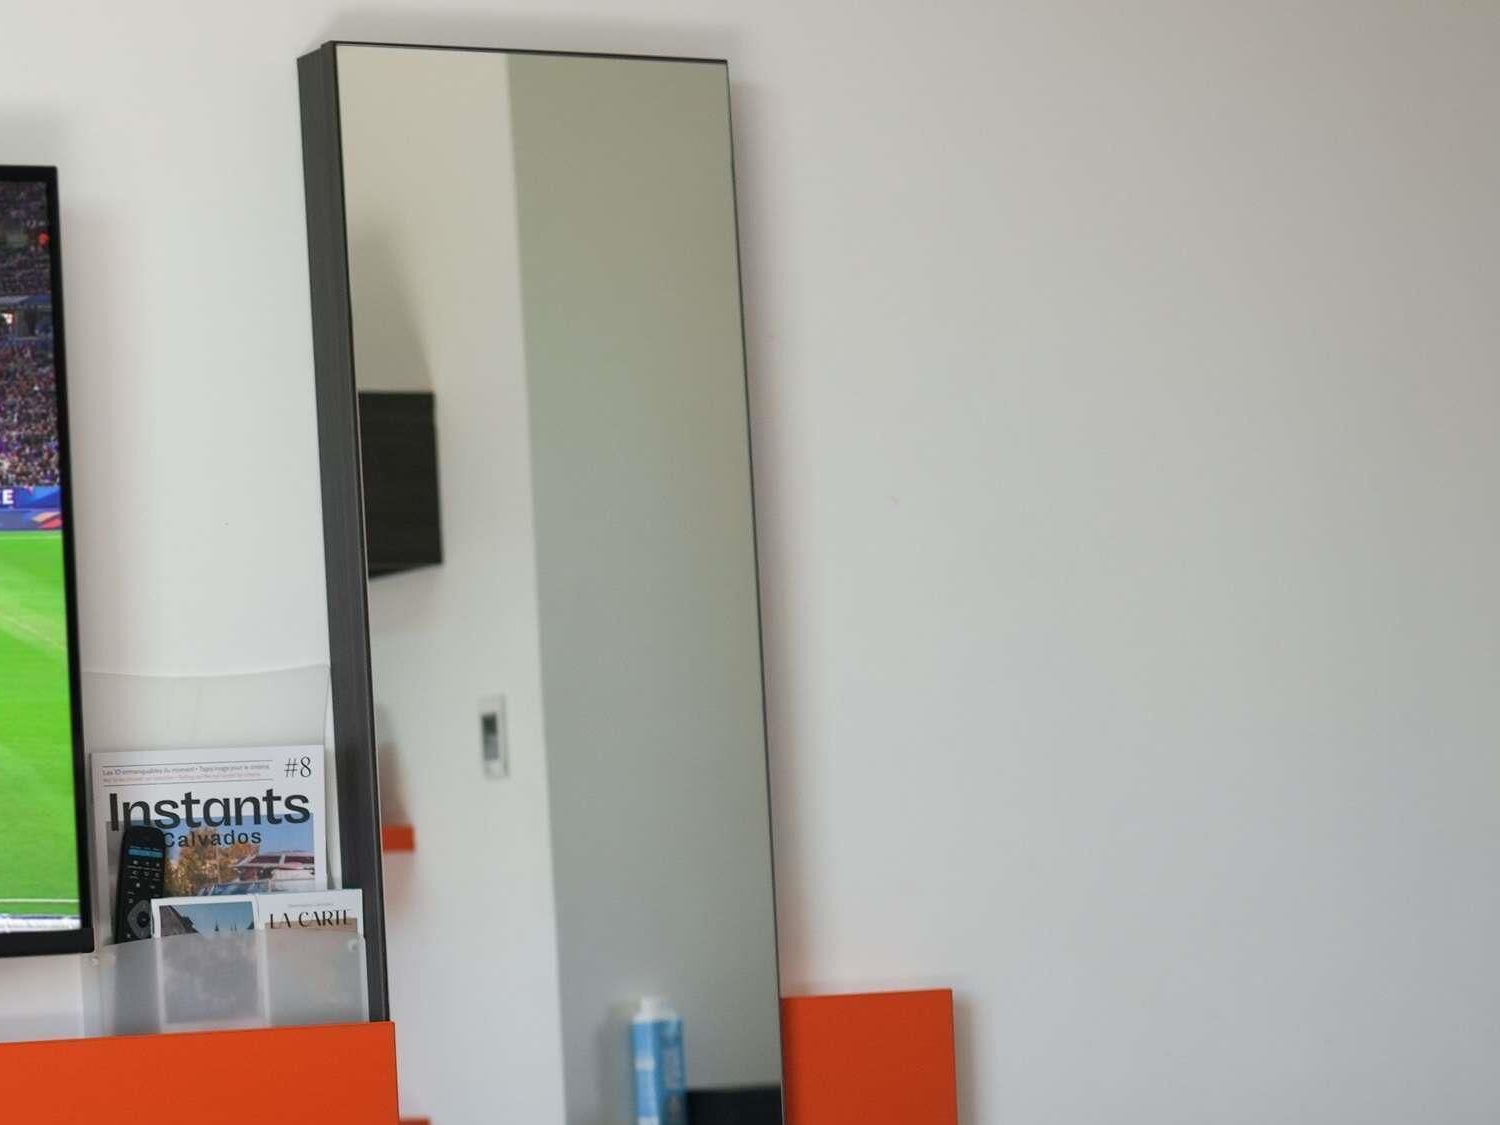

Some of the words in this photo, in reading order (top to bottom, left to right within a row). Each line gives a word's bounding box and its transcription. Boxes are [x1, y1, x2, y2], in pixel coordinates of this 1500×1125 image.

[285, 756, 312, 778] #8
[109, 788, 312, 831] Instants
[164, 829, 262, 848] Calvados
[269, 912, 291, 929] LA
